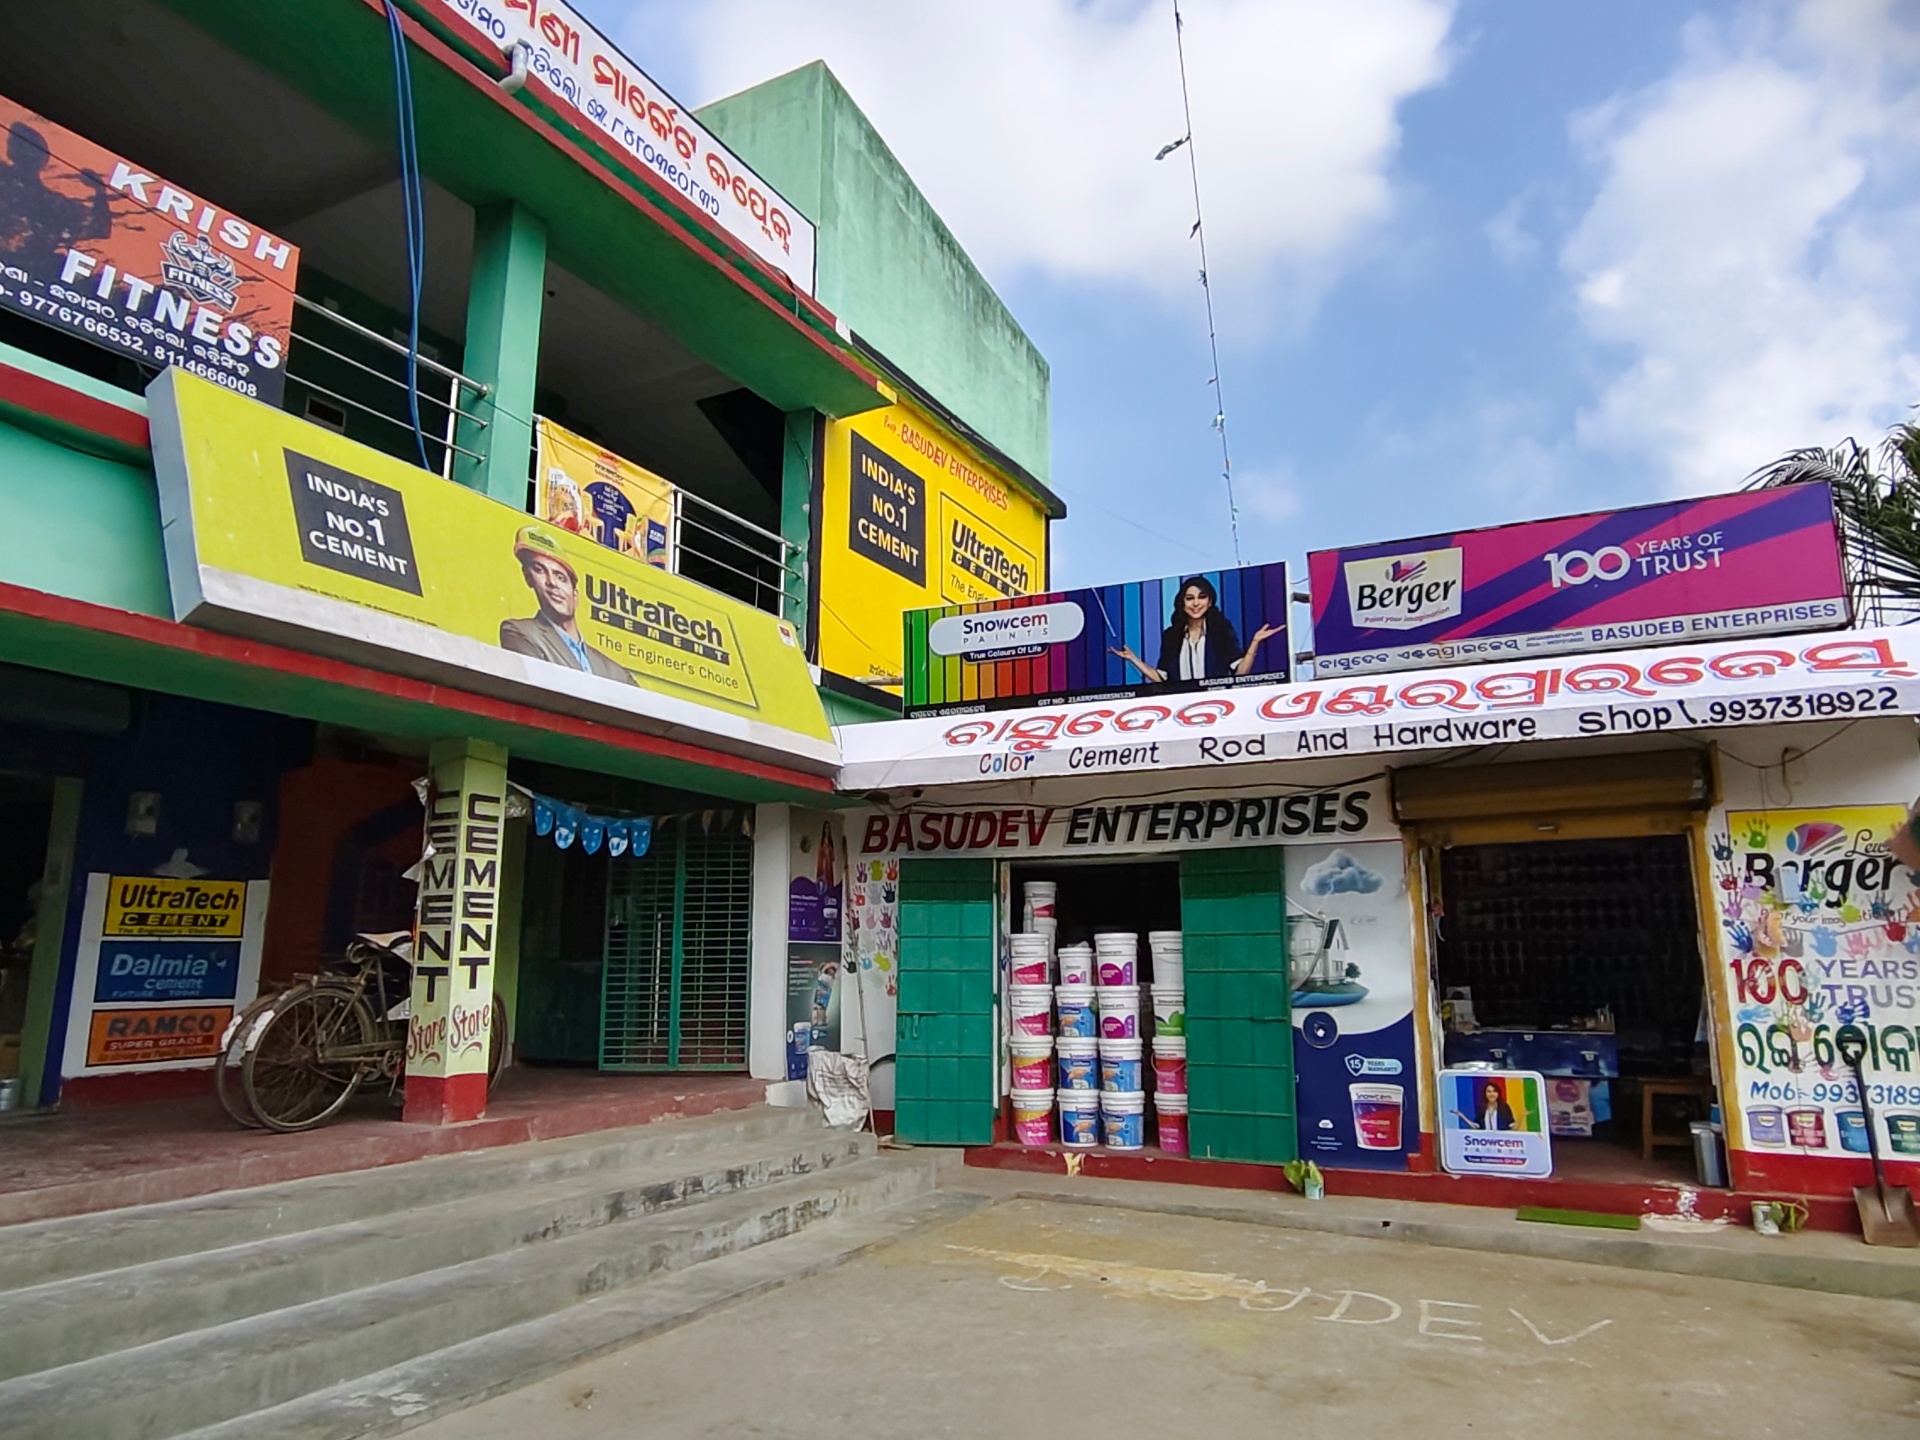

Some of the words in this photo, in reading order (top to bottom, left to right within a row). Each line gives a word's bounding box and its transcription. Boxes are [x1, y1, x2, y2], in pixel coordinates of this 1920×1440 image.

[109, 162, 290, 270] KRISH
[168, 266, 234, 306] FITNESS
[60, 249, 281, 369] FITNESS
[154, 345, 258, 397] 8114666008
[861, 453, 916, 506] INDIA'S
[901, 423, 948, 469] BASUDEV
[949, 455, 1009, 511] ENTERPRISES
[306, 472, 390, 518] INDIA'S
[872, 494, 908, 532] NO.1
[325, 511, 386, 547] NO.1
[857, 519, 919, 567] CEMENT
[308, 530, 408, 576] CEMENT
[951, 518, 1028, 592] UltraTech
[1543, 545, 1631, 588] 100
[1636, 535, 1692, 555] YEARS
[1697, 531, 1724, 547] OF
[1636, 547, 1724, 577] TRUST
[951, 573, 966, 593] The
[1356, 576, 1457, 613] Berger
[585, 573, 723, 648] UltraTech
[963, 613, 1048, 635] Snowcem
[1384, 616, 1402, 624] your
[1404, 606, 1450, 622] imagination
[1591, 619, 1685, 642] BASUDEB
[1692, 603, 1837, 632] ENTERPRISES
[599, 611, 724, 661] CEMENT
[963, 628, 1048, 645] PAINTS
[970, 651, 986, 660] True
[987, 648, 1016, 659] Colours
[1017, 645, 1027, 655] Of
[1028, 645, 1042, 654] Life
[596, 632, 622, 653] The
[628, 643, 695, 676] Engineer's
[699, 666, 739, 690] Choice
[1235, 671, 1285, 684] ENTERPRISES
[1038, 698, 1051, 707] GST
[979, 752, 1035, 774] Color
[1068, 741, 1160, 769] Cement
[1199, 734, 1266, 763] Rod
[1297, 727, 1348, 753] And
[1373, 716, 1537, 747] Hardware
[861, 807, 1054, 854] BASUDEV
[1066, 791, 1372, 847] ENTERPRISES
[119, 884, 240, 910] UltraTech
[416, 789, 460, 1003] CEMENT
[458, 792, 502, 991] CEMENT
[123, 914, 228, 927] CEMENT
[110, 953, 209, 976] Dalmia
[1816, 958, 1919, 980] YEARS
[1820, 984, 1920, 1010] TRUS
[107, 1014, 215, 1037] RAMCO
[109, 1040, 154, 1051] SUPER
[158, 1036, 203, 1047] GRADE
[407, 1013, 447, 1060] Store
[449, 1003, 490, 1048] Store
[1349, 1059, 1362, 1069] 15
[1356, 1092, 1393, 1100] Snowcem
[1464, 1134, 1524, 1148] Snowcem
